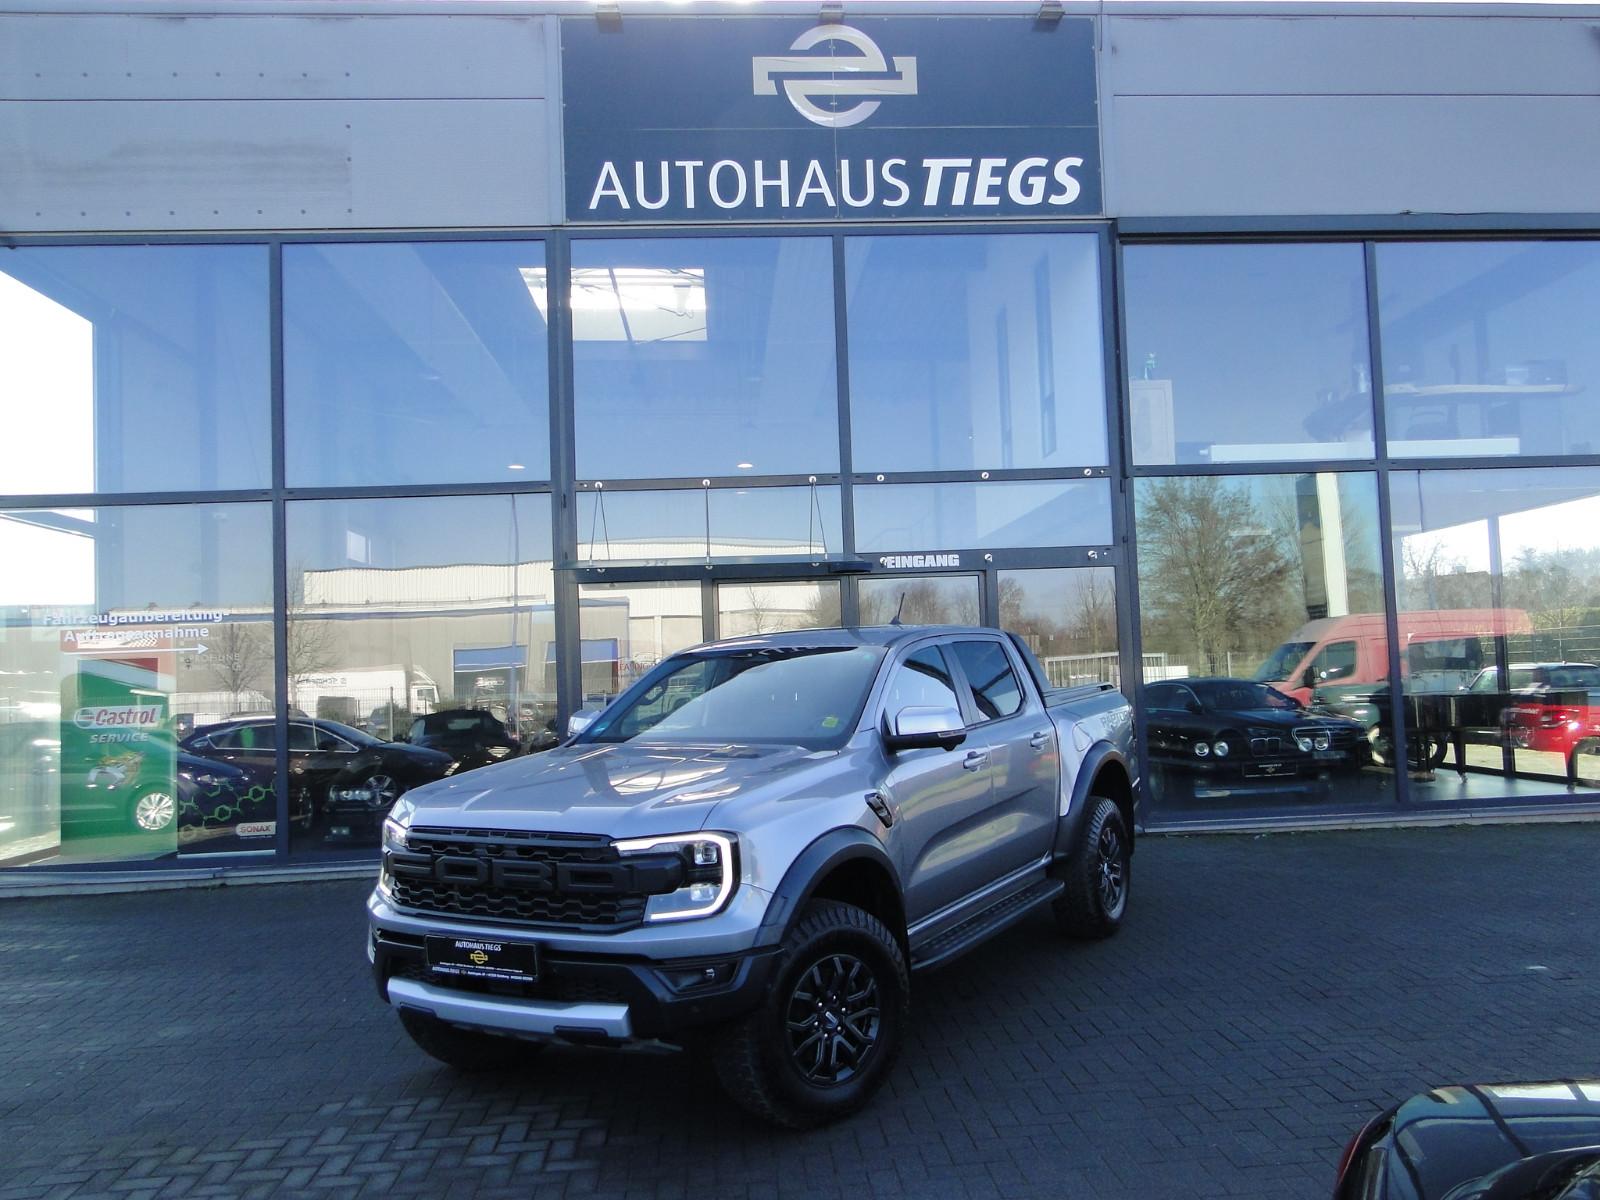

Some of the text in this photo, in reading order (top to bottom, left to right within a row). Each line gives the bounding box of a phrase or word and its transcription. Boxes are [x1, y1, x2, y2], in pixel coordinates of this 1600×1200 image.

[589, 158, 910, 210] AUTOHAUS
[886, 554, 960, 569] EINGANG
[95, 707, 157, 726] Castrol
[89, 732, 150, 744] SERVICE
[240, 825, 272, 833] SONAX
[382, 850, 633, 892] FORD
[455, 940, 485, 950] AUTOHAUS
